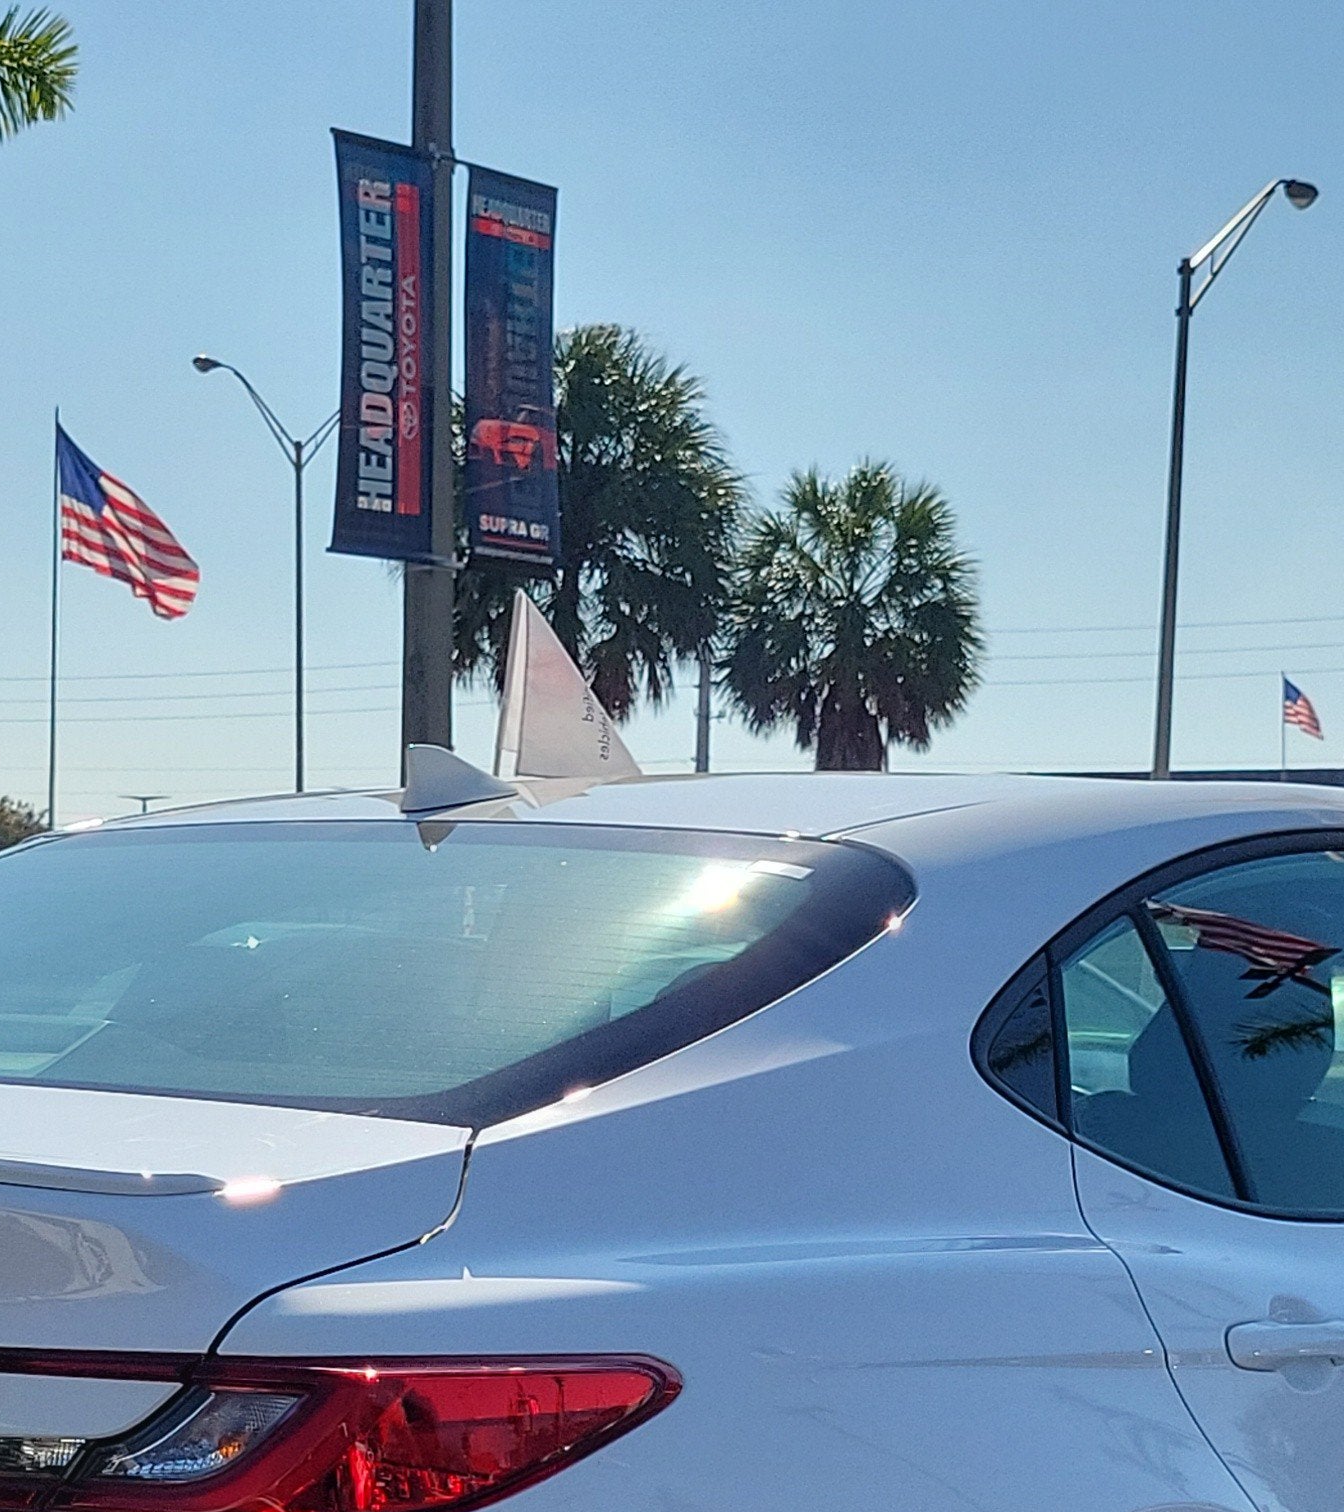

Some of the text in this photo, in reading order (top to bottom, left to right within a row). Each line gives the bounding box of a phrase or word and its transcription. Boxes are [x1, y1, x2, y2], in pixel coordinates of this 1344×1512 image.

[357, 178, 397, 513] HEADQUARTER
[401, 276, 417, 394] TOYOTA
[479, 514, 528, 538] SUPRA
